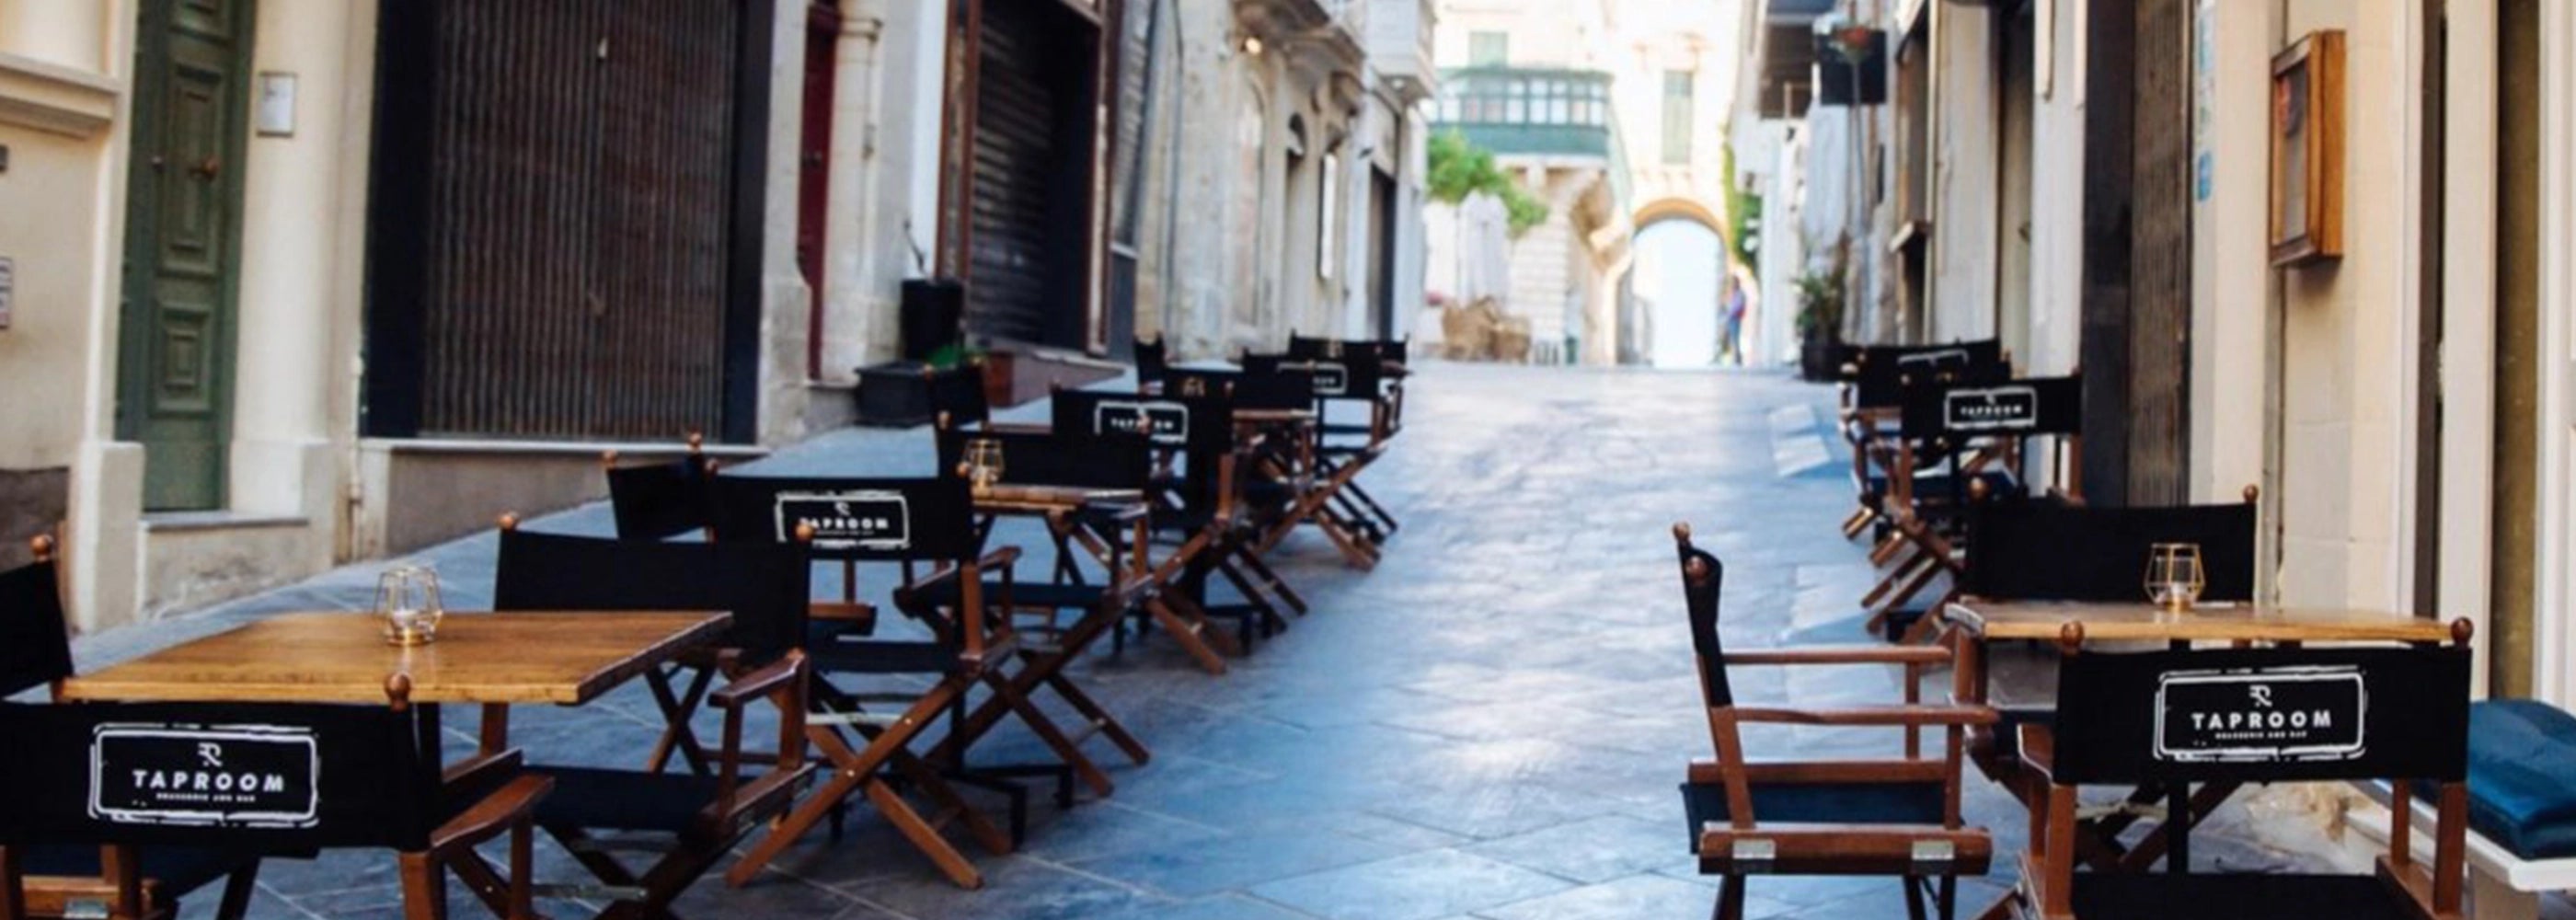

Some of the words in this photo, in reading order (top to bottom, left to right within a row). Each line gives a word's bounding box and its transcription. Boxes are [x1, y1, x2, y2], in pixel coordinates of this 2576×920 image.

[1110, 418, 1174, 430] TAPOM
[2191, 710, 2331, 730] TAPROOM
[132, 770, 283, 792] TAPROOM
